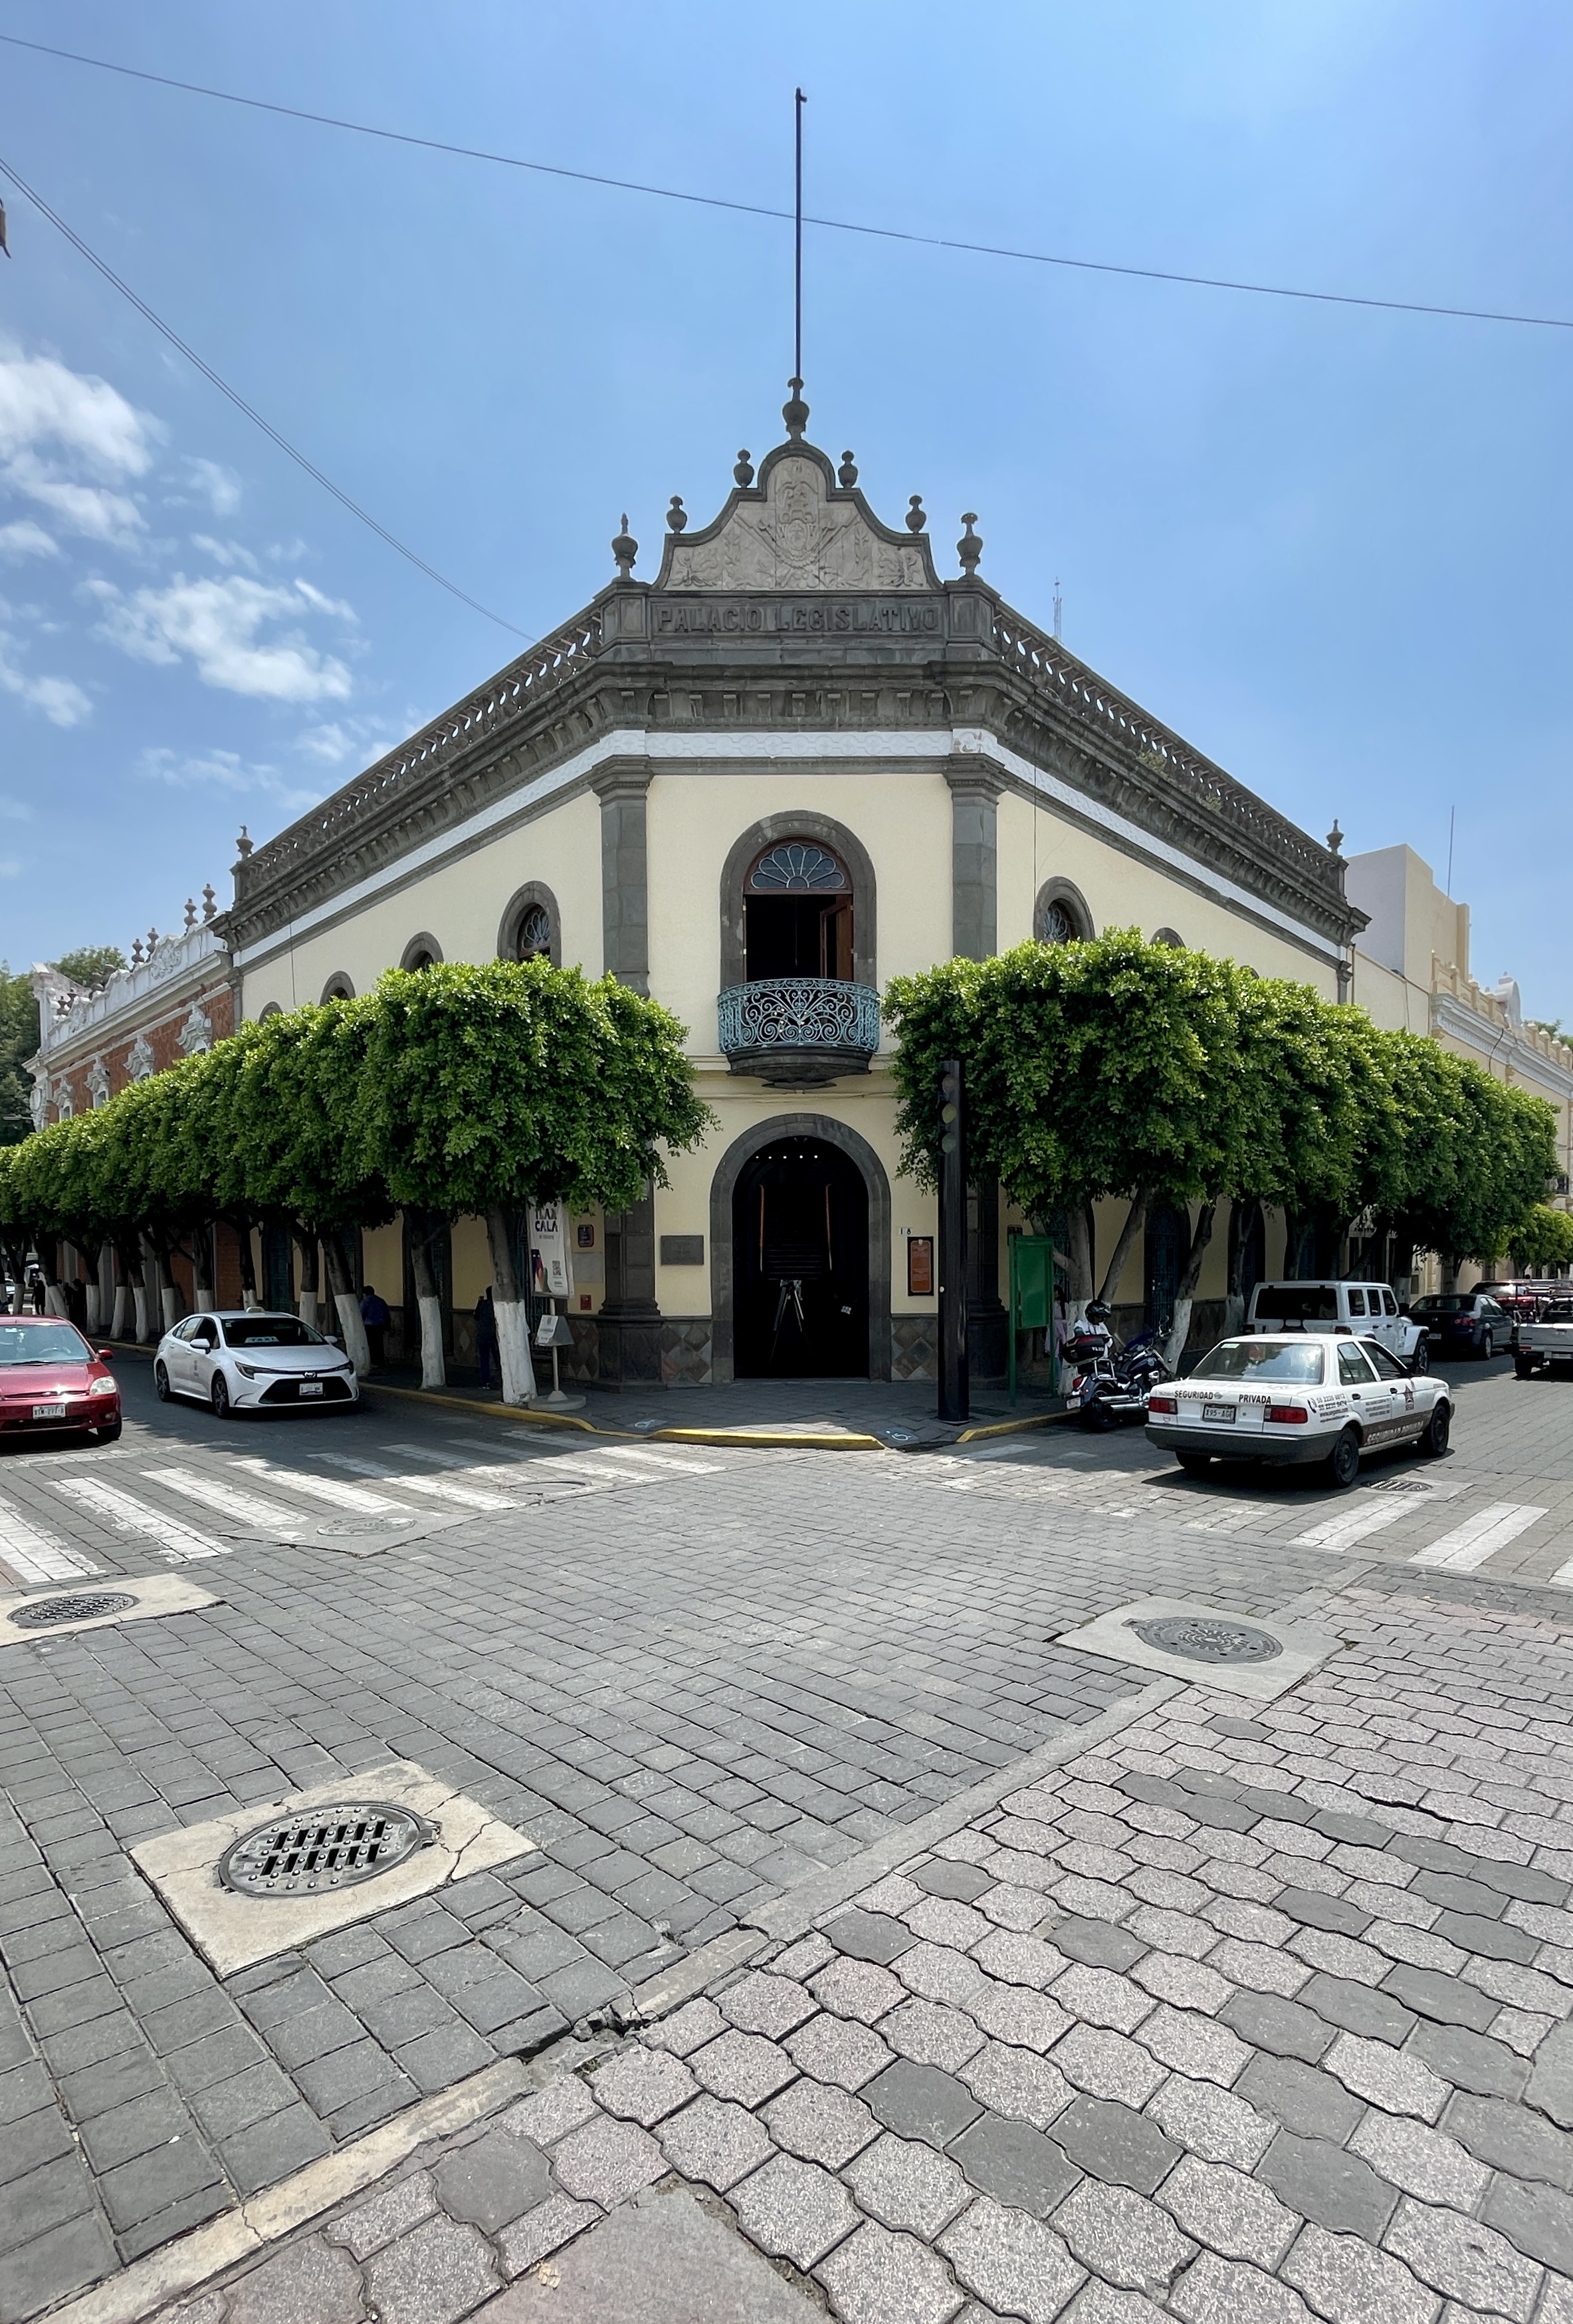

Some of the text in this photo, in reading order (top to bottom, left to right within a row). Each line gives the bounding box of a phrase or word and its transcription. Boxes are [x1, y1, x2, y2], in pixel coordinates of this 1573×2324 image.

[657, 606, 938, 632] PALACIO LEGISLATIVO
[535, 1220, 558, 1232] CALA
[1174, 1390, 1213, 1400] SEGURIDAD
[1239, 1394, 1271, 1404] PRIVADA
